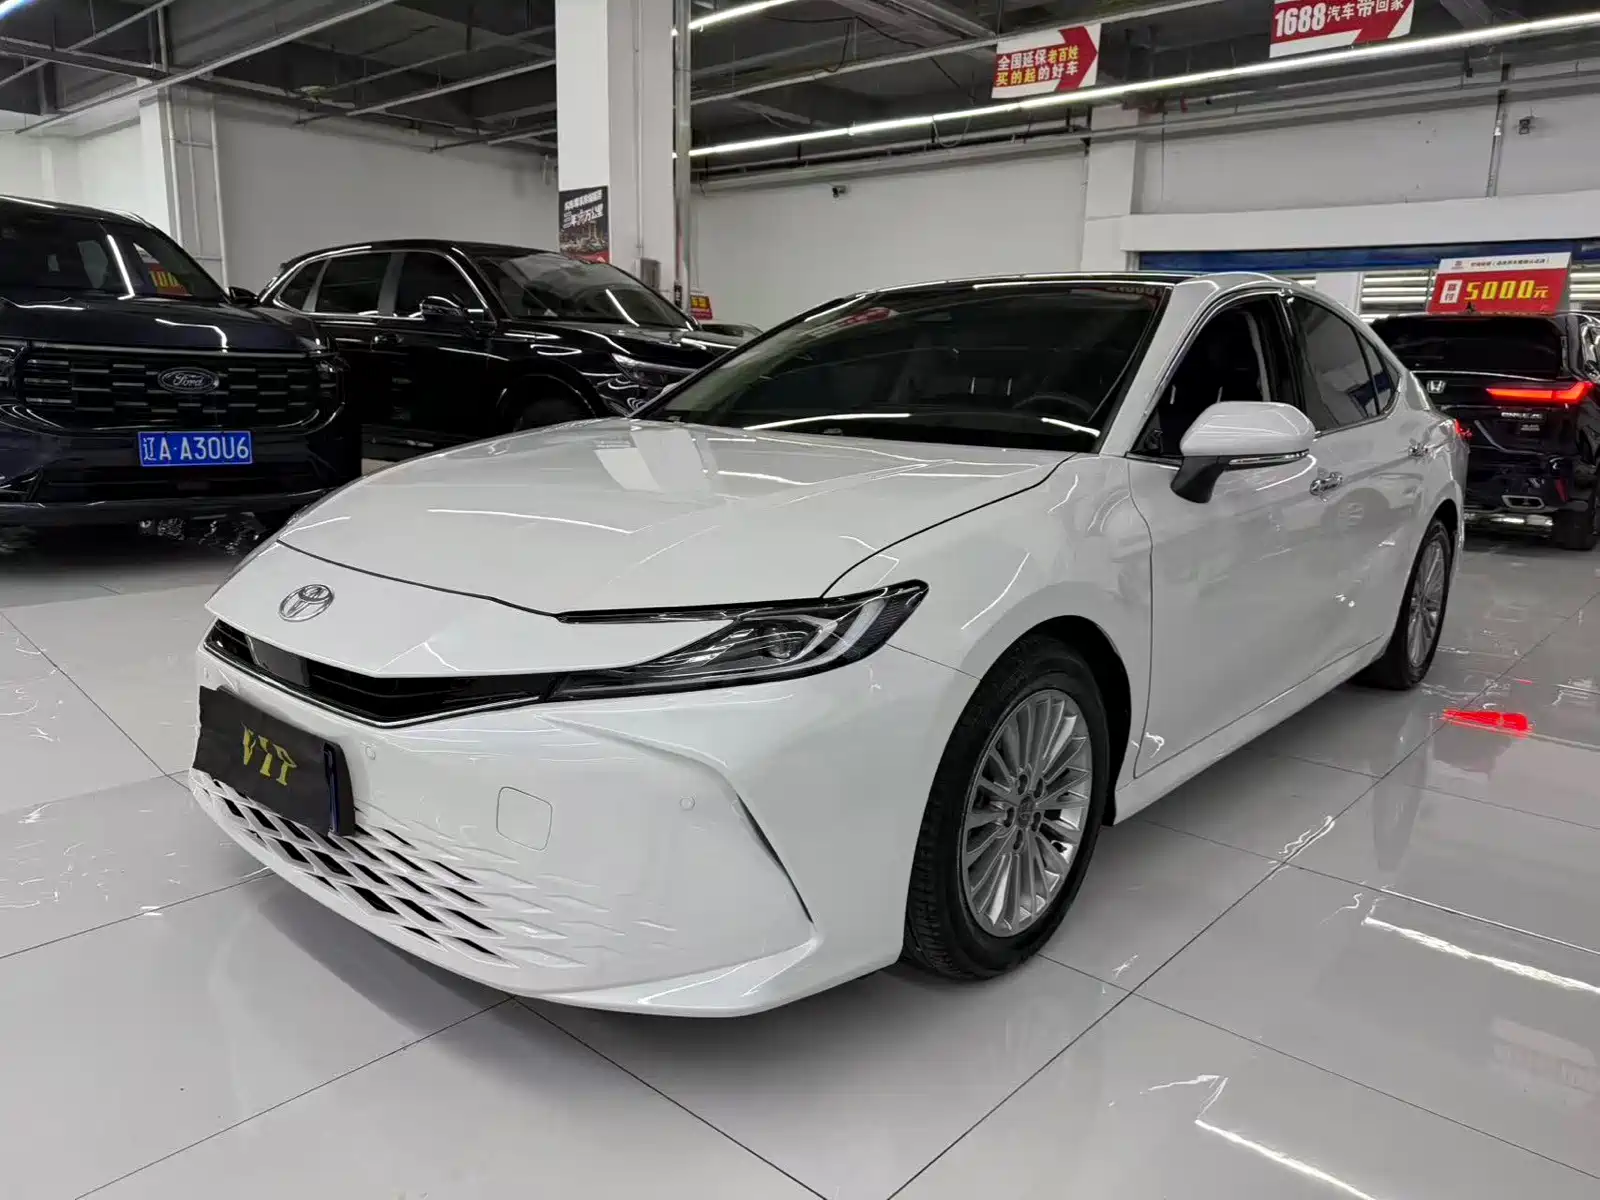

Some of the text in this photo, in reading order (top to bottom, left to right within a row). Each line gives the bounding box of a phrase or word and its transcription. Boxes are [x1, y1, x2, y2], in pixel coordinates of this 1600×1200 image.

[997, 45, 1079, 71] 全国延保老百姓
[996, 61, 1079, 87] 买的起的好车
[1464, 280, 1549, 300] 5000元
[173, 373, 205, 387] Ford
